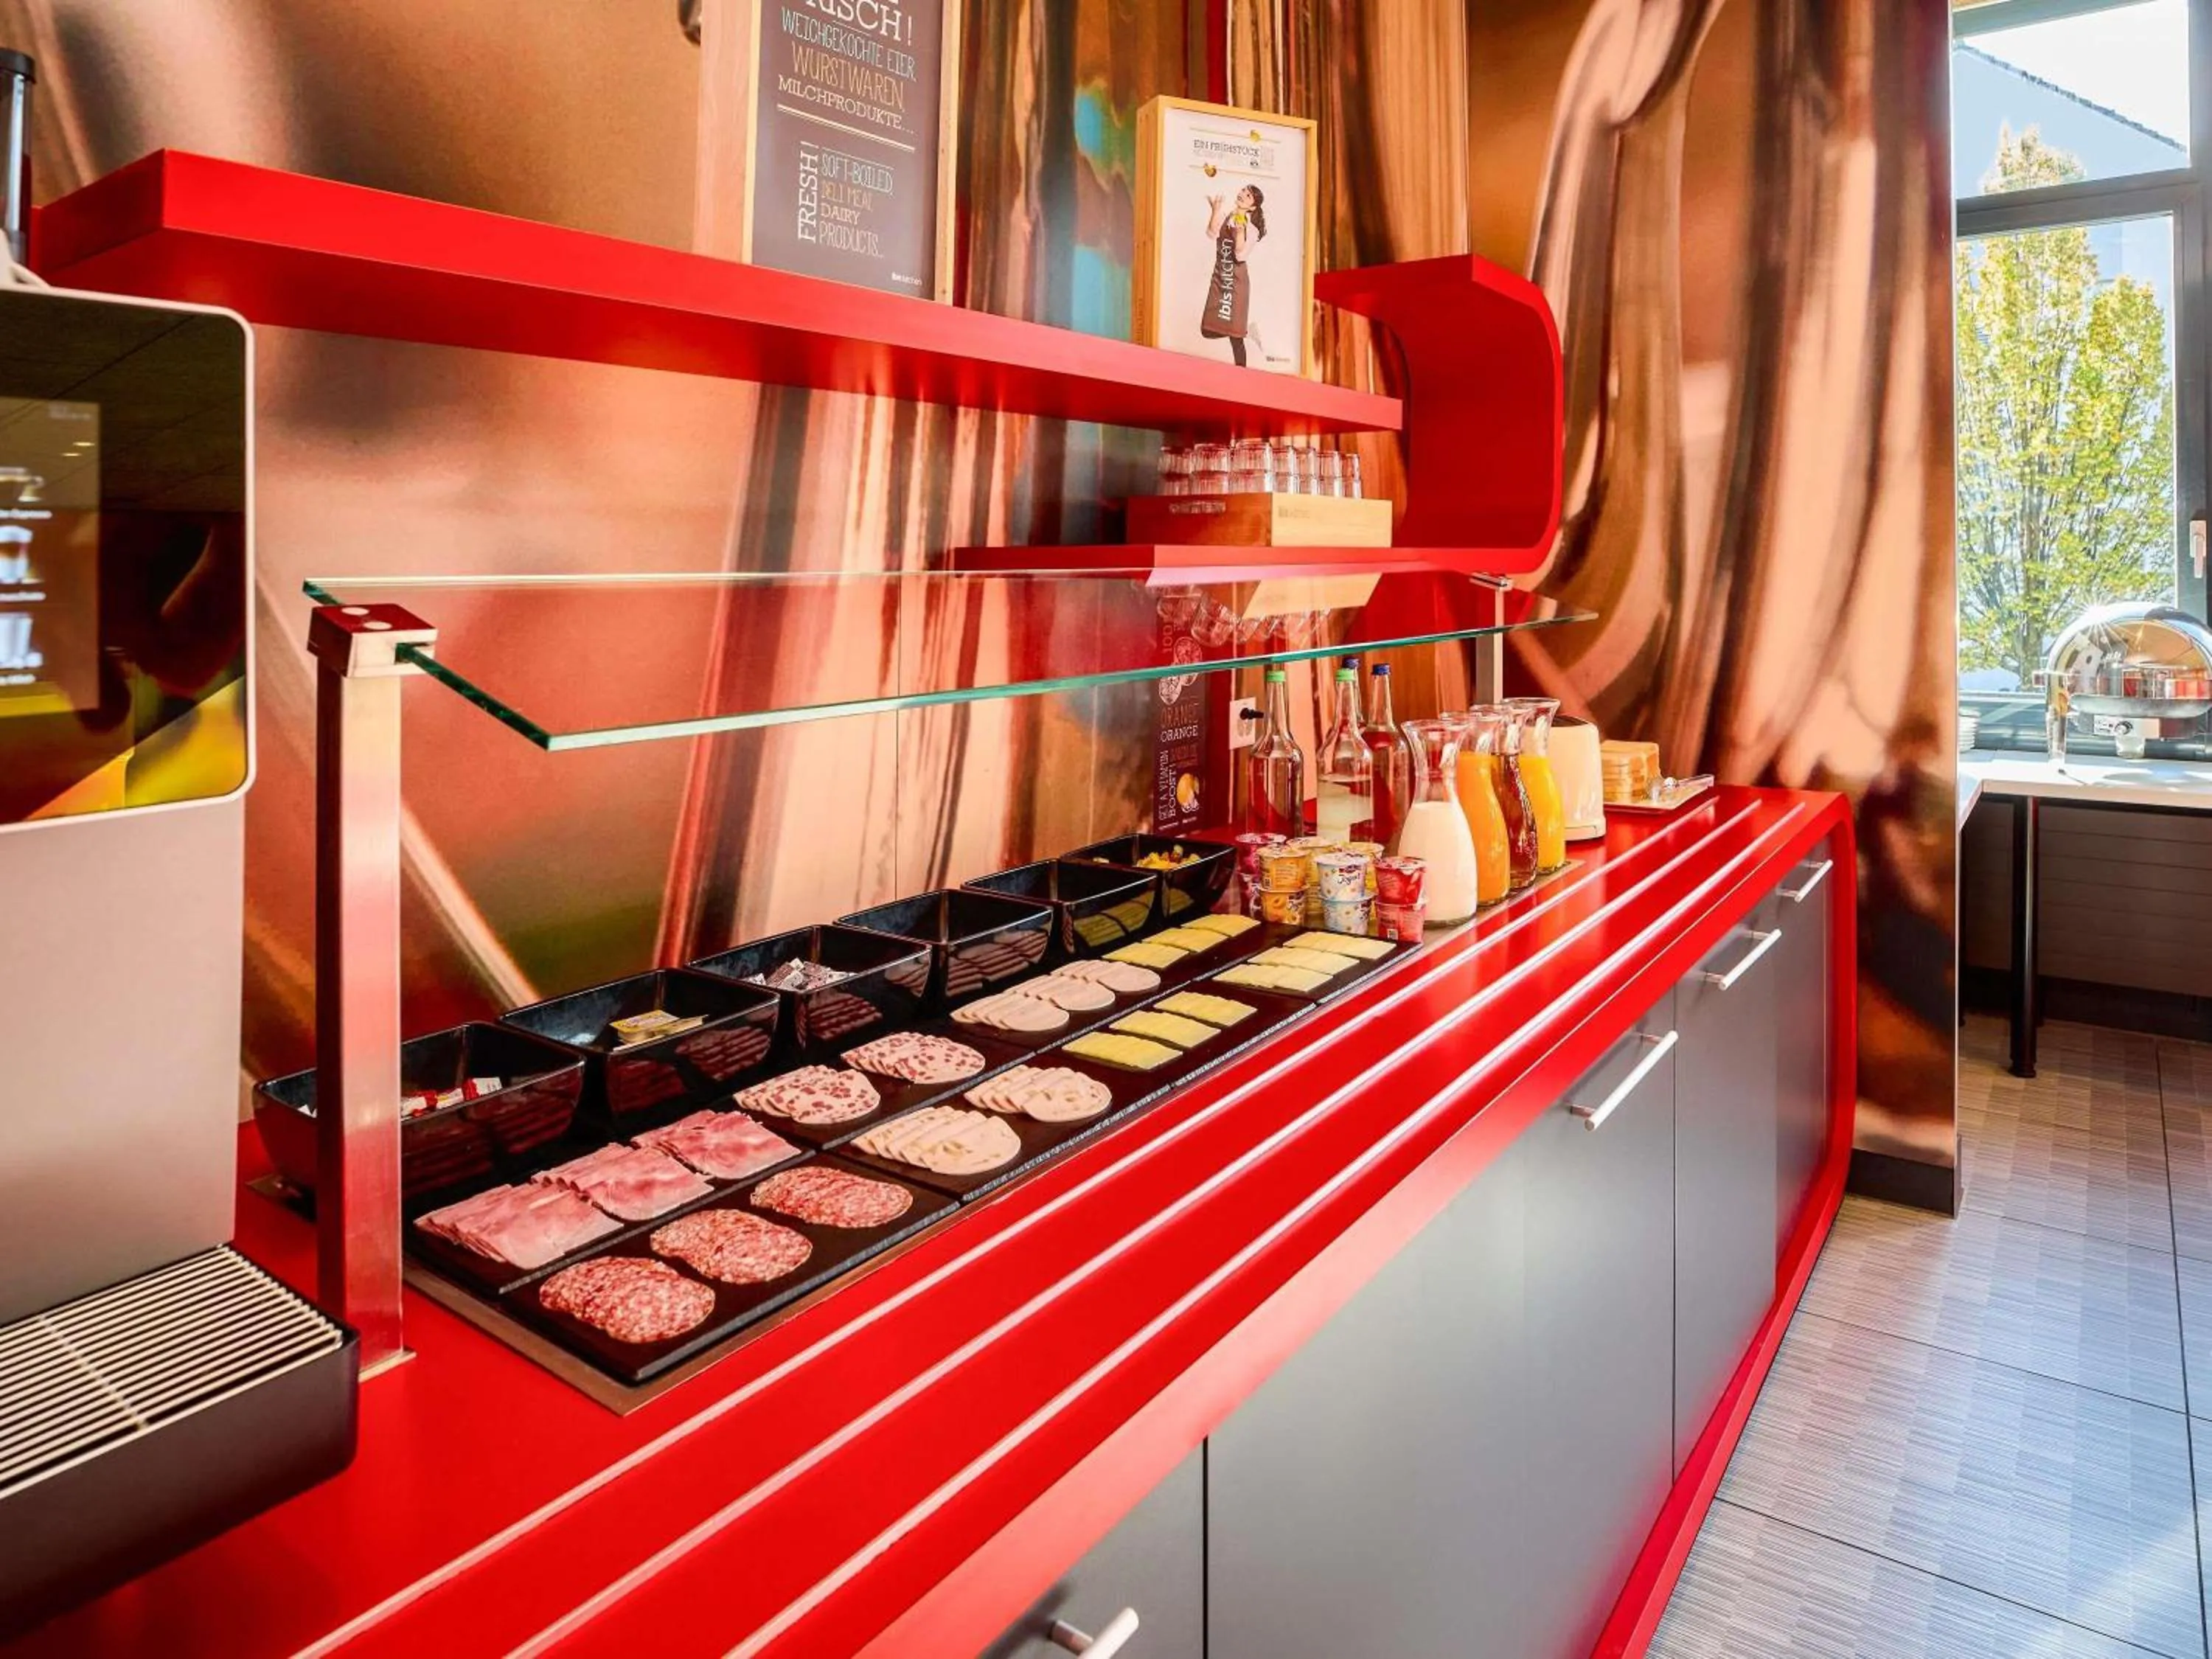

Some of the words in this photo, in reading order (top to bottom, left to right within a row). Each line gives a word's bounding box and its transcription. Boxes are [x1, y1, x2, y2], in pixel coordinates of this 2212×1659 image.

[781, 6, 884, 69] WEICHGEKOCHTE
[820, 202, 861, 226] DAIRY
[1217, 291, 1233, 321] ibis
[1161, 725, 1198, 743] ORANGE
